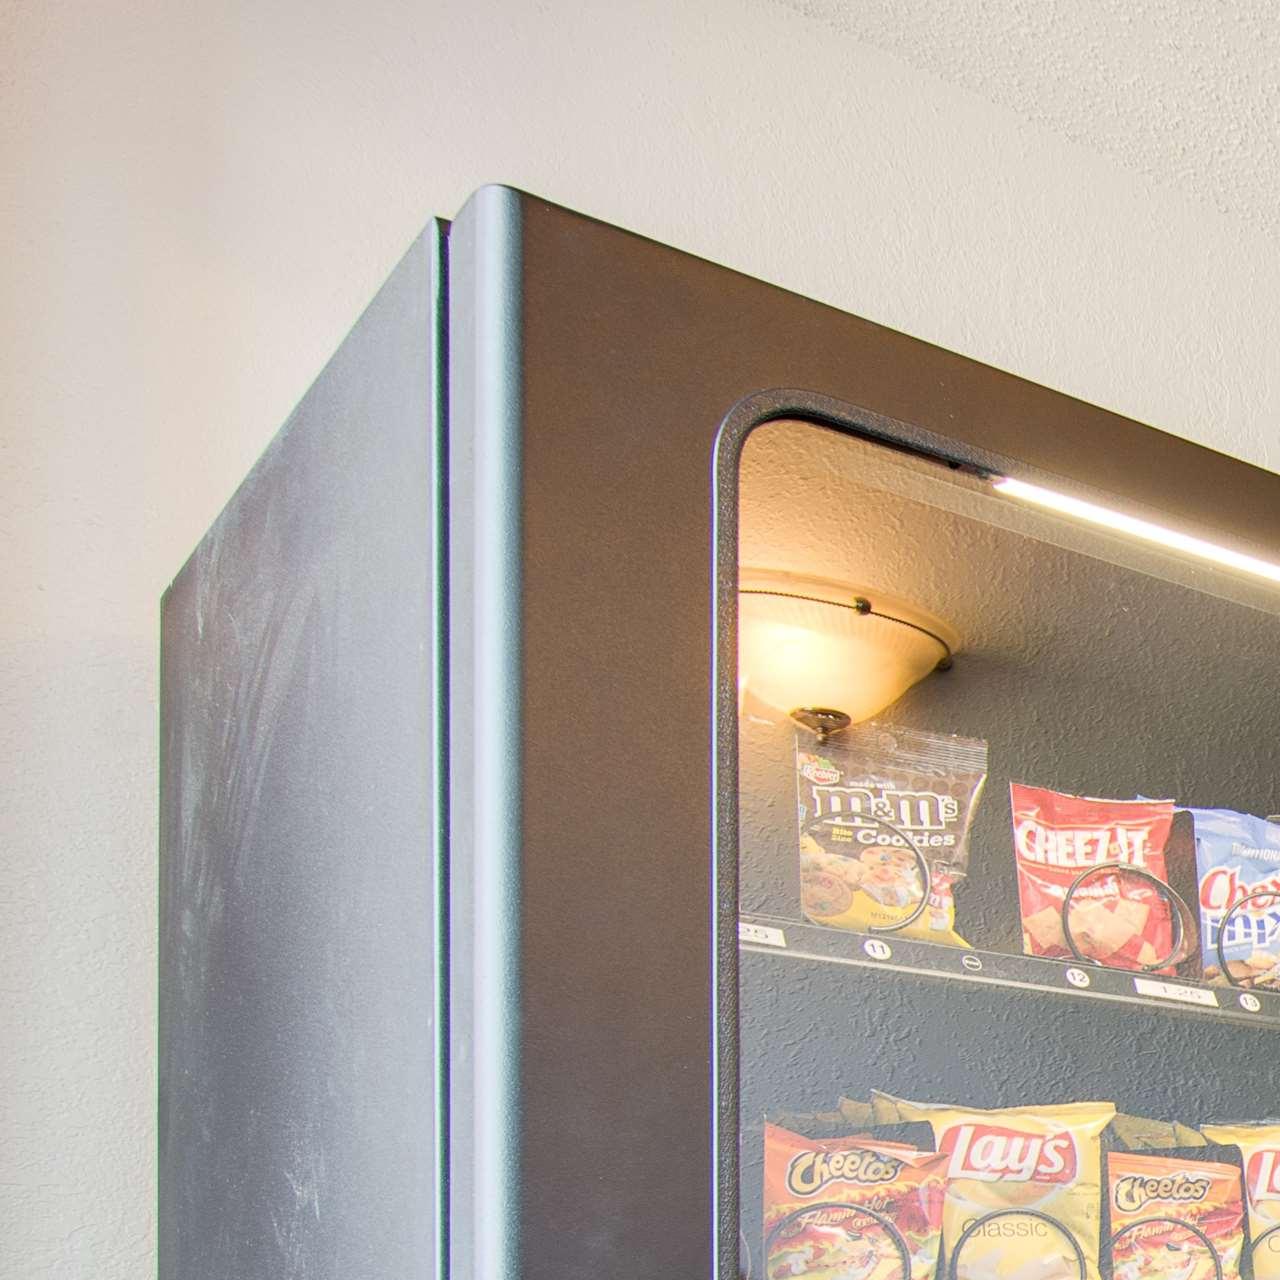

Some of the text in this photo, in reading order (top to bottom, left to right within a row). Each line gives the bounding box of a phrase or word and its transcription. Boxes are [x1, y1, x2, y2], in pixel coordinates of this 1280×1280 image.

[856, 829, 956, 847] Cookies
[870, 943, 886, 955] 11
[1070, 972, 1087, 984] 12
[1244, 997, 1258, 1009] 13
[949, 1126, 1071, 1182] Lay's
[787, 1150, 903, 1196] Cheetos
[1115, 1174, 1211, 1212] Cheetos
[962, 1217, 1047, 1238] Classic
